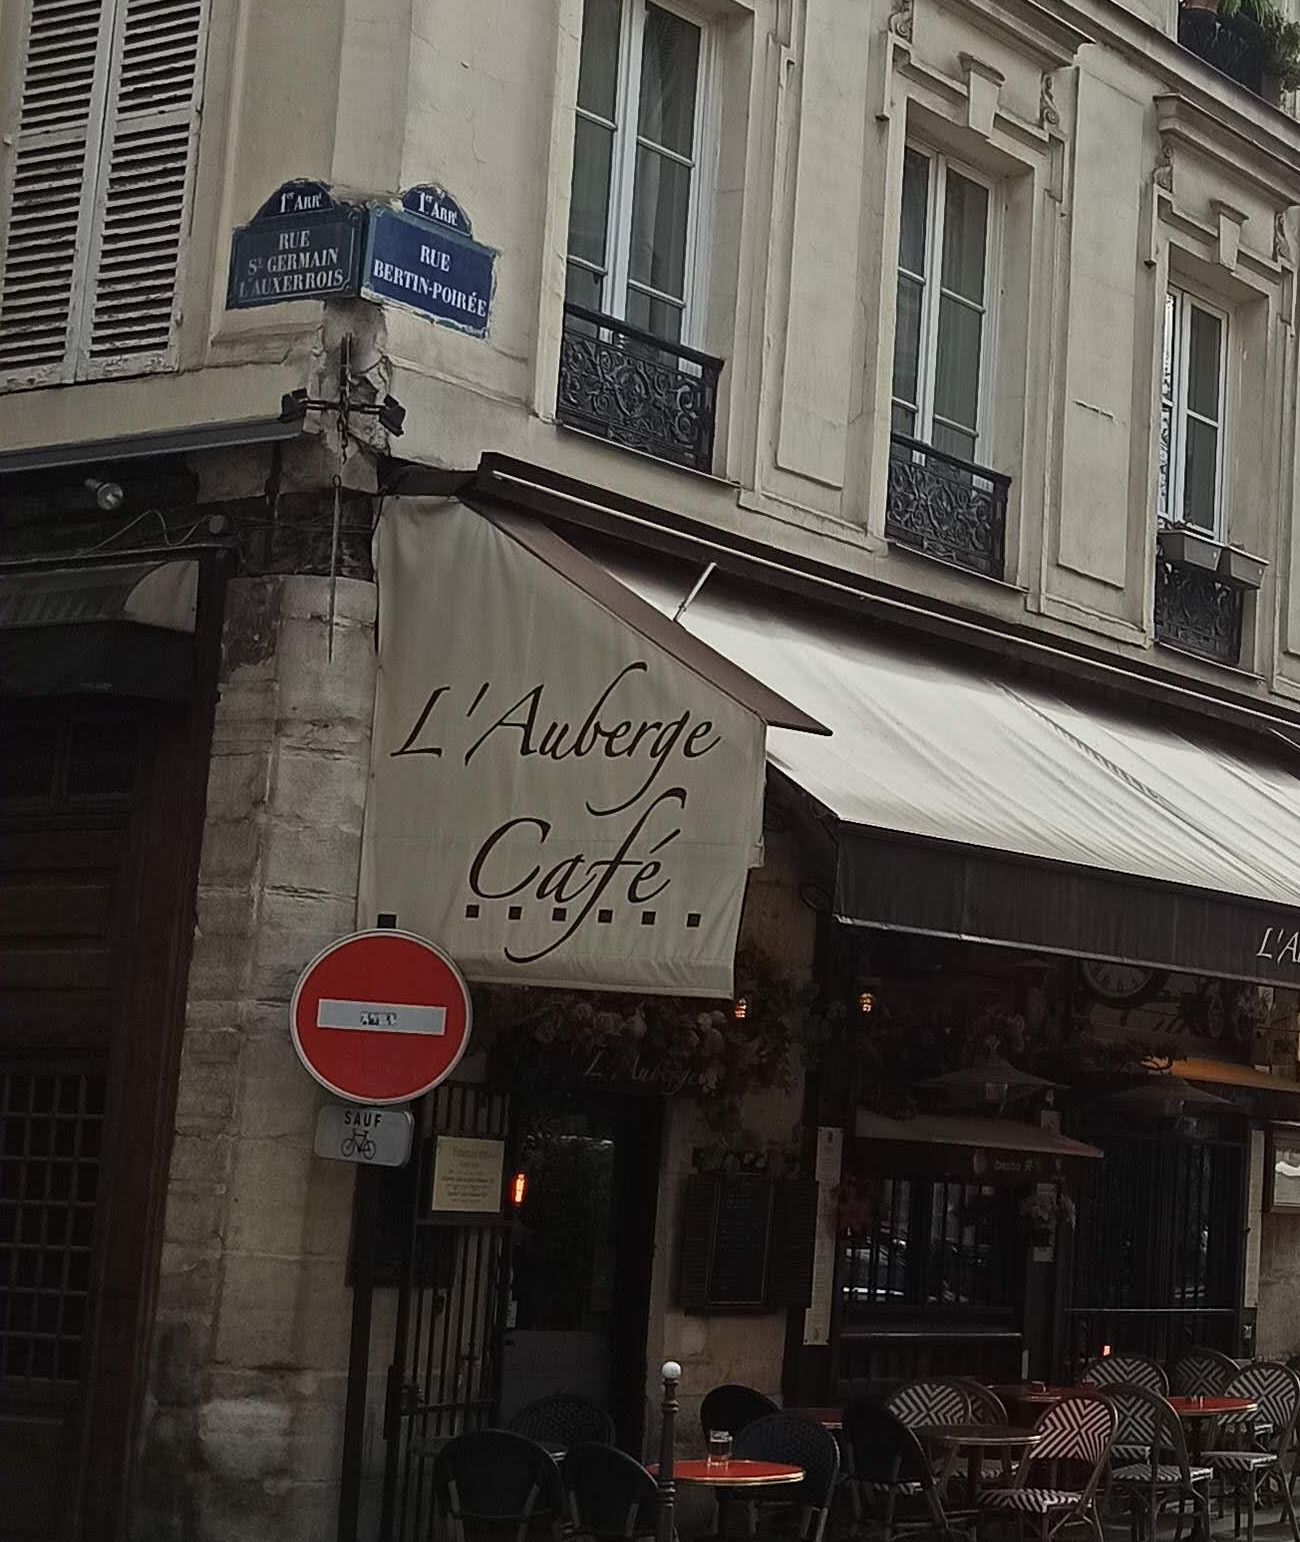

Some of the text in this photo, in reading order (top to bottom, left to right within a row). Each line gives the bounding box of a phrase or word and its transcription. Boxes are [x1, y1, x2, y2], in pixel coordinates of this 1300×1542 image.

[279, 230, 310, 250] RUE
[267, 248, 338, 273] GERMAIN
[420, 245, 450, 273] RUE
[373, 259, 487, 317] BERTIN-POIRÉE
[390, 661, 722, 817] L'Auberge
[468, 787, 687, 963] Café
[344, 1110, 382, 1128] SAUF
